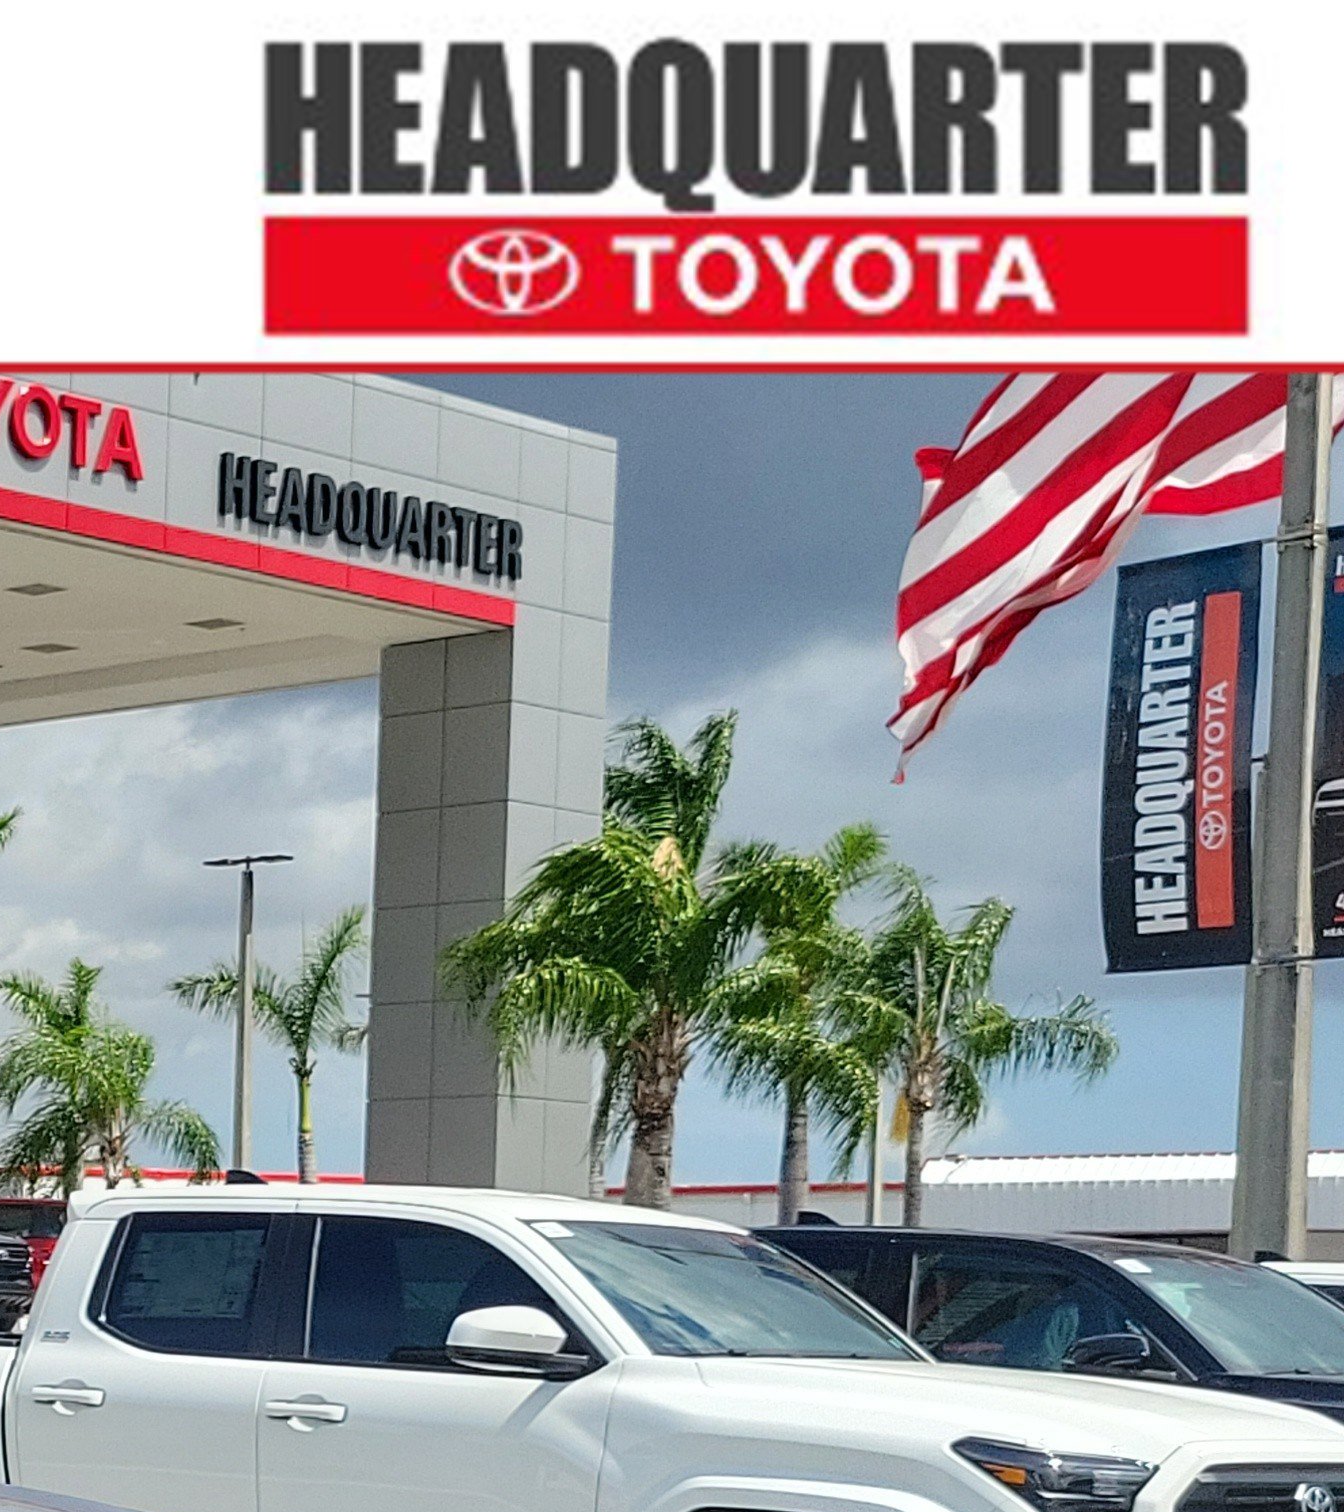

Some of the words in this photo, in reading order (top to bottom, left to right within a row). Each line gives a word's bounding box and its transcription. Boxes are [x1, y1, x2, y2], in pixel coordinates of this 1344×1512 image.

[217, 452, 523, 581] HEADQUARTER
[1134, 599, 1197, 935] HEADQUARTER
[1200, 680, 1229, 808] TOYOTA
